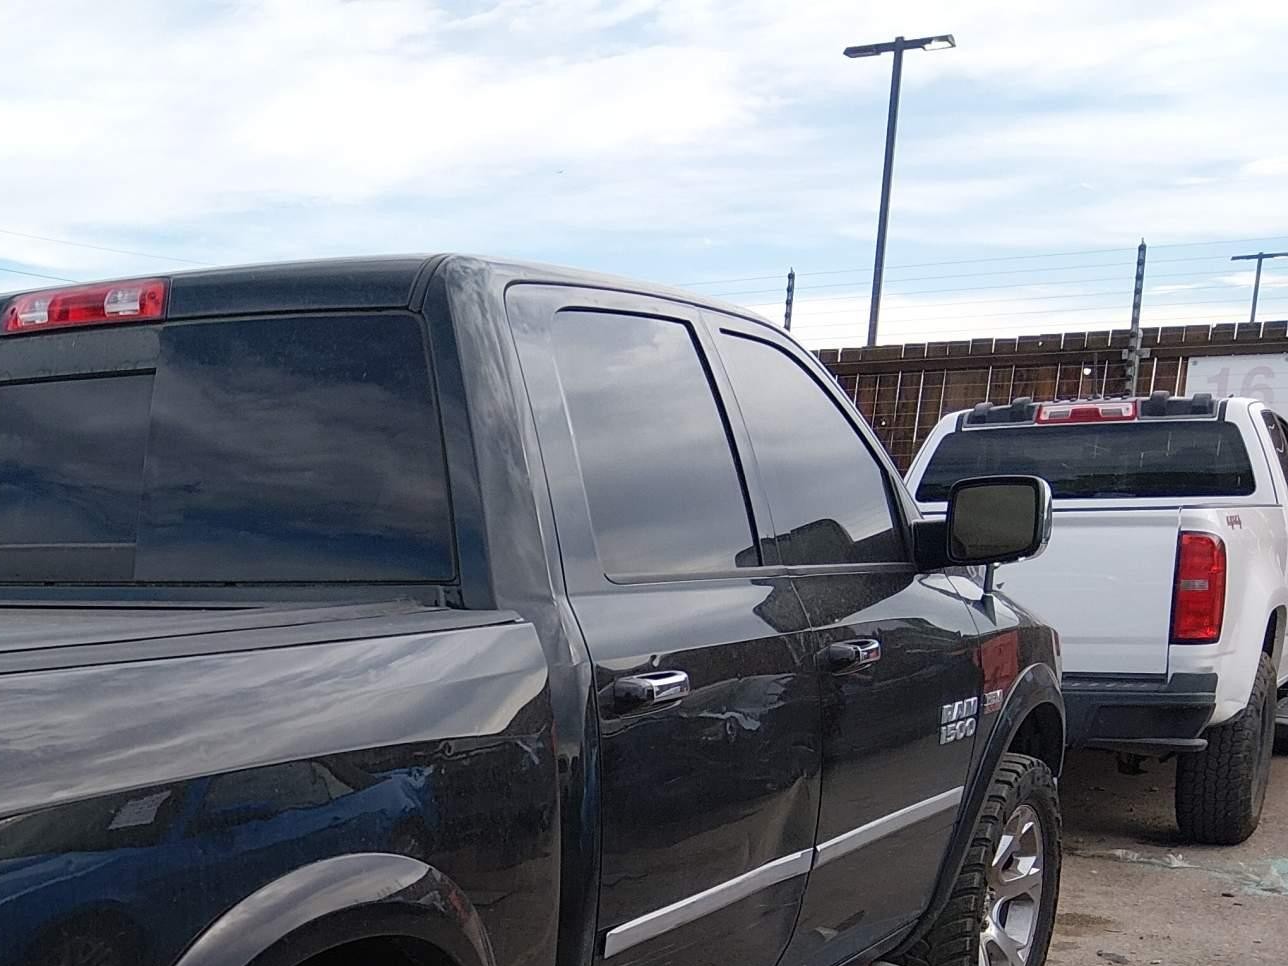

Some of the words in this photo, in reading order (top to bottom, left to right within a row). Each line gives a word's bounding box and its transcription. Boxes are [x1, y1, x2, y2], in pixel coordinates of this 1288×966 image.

[1207, 365, 1275, 406] 16
[941, 696, 978, 725] RAM
[939, 717, 977, 745] 1500
